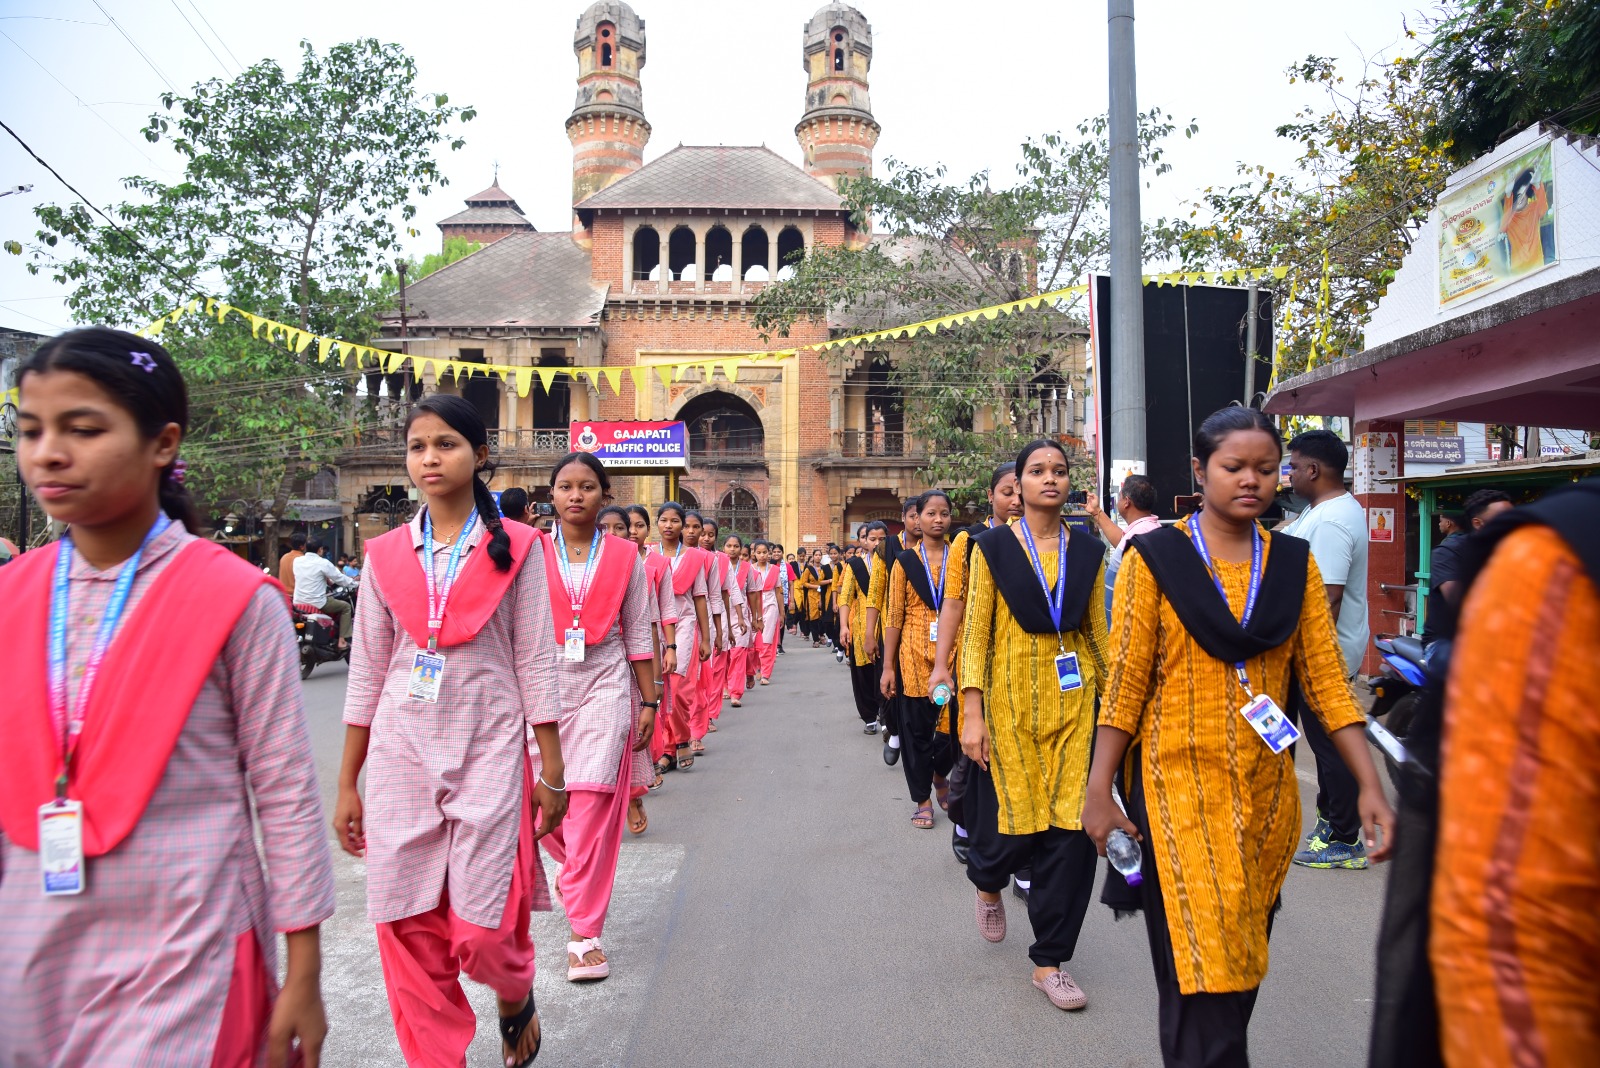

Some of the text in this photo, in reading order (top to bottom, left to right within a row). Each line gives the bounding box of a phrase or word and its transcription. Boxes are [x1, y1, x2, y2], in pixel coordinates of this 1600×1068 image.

[613, 429, 671, 439] GAJAPATI
[604, 443, 681, 453] TRAFFIC POLICE
